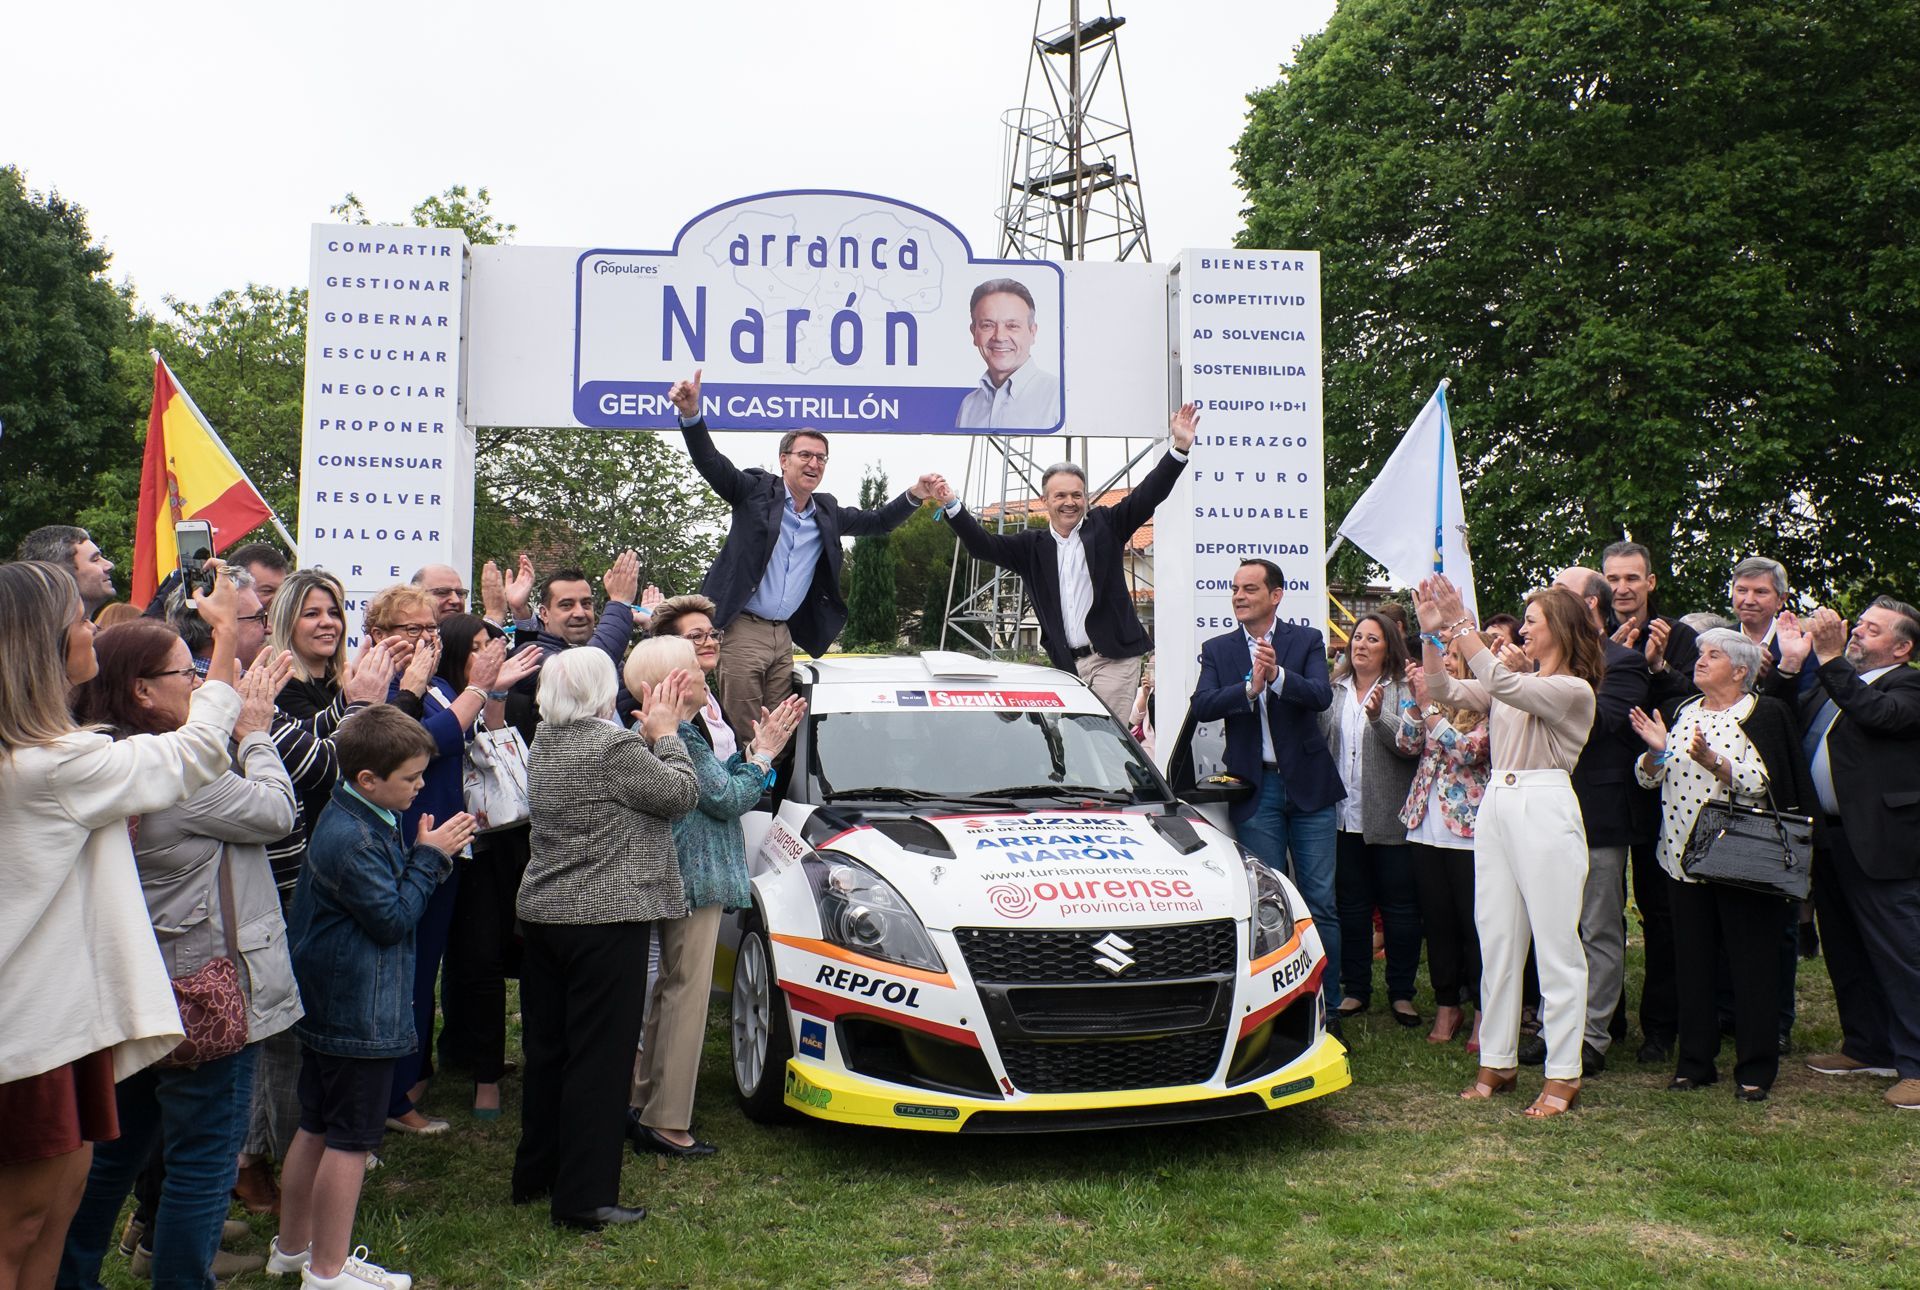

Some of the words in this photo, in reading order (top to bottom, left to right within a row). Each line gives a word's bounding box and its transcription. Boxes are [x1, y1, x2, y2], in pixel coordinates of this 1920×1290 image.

[328, 241, 451, 256] COMPARTIR
[729, 233, 918, 270] arranca
[601, 263, 658, 275] populares
[1201, 259, 1304, 271] BIENESTAR
[326, 276, 450, 291] GESTIONAR
[1192, 293, 1305, 306] COMPETITIVID
[324, 312, 448, 326] GOBERNAR
[662, 285, 918, 366] Narón
[1193, 329, 1213, 339] AD
[1222, 329, 1305, 341] SOLVENCIA
[323, 347, 447, 362] ESCUCHAR
[1193, 364, 1306, 377] SOSTENIBILIDA
[321, 383, 445, 398] NEGOCIAR
[599, 393, 721, 417] GERMN
[727, 393, 899, 419] CASTRILLÓN
[1194, 400, 1203, 410] D
[1208, 400, 1265, 411] EQUIPO
[1270, 401, 1306, 412] I+D+I
[319, 419, 444, 433] PROPONER
[1194, 435, 1307, 447] LIDERAZGO
[318, 455, 443, 469] CONSENSUAR
[1194, 471, 1308, 483] FUTURO
[316, 491, 441, 505] RESOLVER
[1195, 507, 1308, 519] SALUDABLE
[315, 528, 440, 542] DIALOGAR
[1195, 543, 1309, 555] DEPORTIVIDAD
[935, 692, 1006, 707] Suzuki
[1009, 698, 1059, 707] Finance
[994, 818, 1128, 826] SUZUKI
[773, 827, 803, 860] ourense
[975, 835, 1143, 850] ARRANCA
[1006, 845, 1135, 864] NARÓN
[980, 867, 1189, 881] www.turismourense.com
[1033, 879, 1194, 901] ourense
[1059, 899, 1145, 918] provincia
[1149, 899, 1203, 912] termal
[1271, 949, 1313, 992] REPSOL
[815, 964, 920, 1008] REPSOL
[802, 1036, 823, 1049] RACE
[899, 1106, 954, 1117] TRADISA
